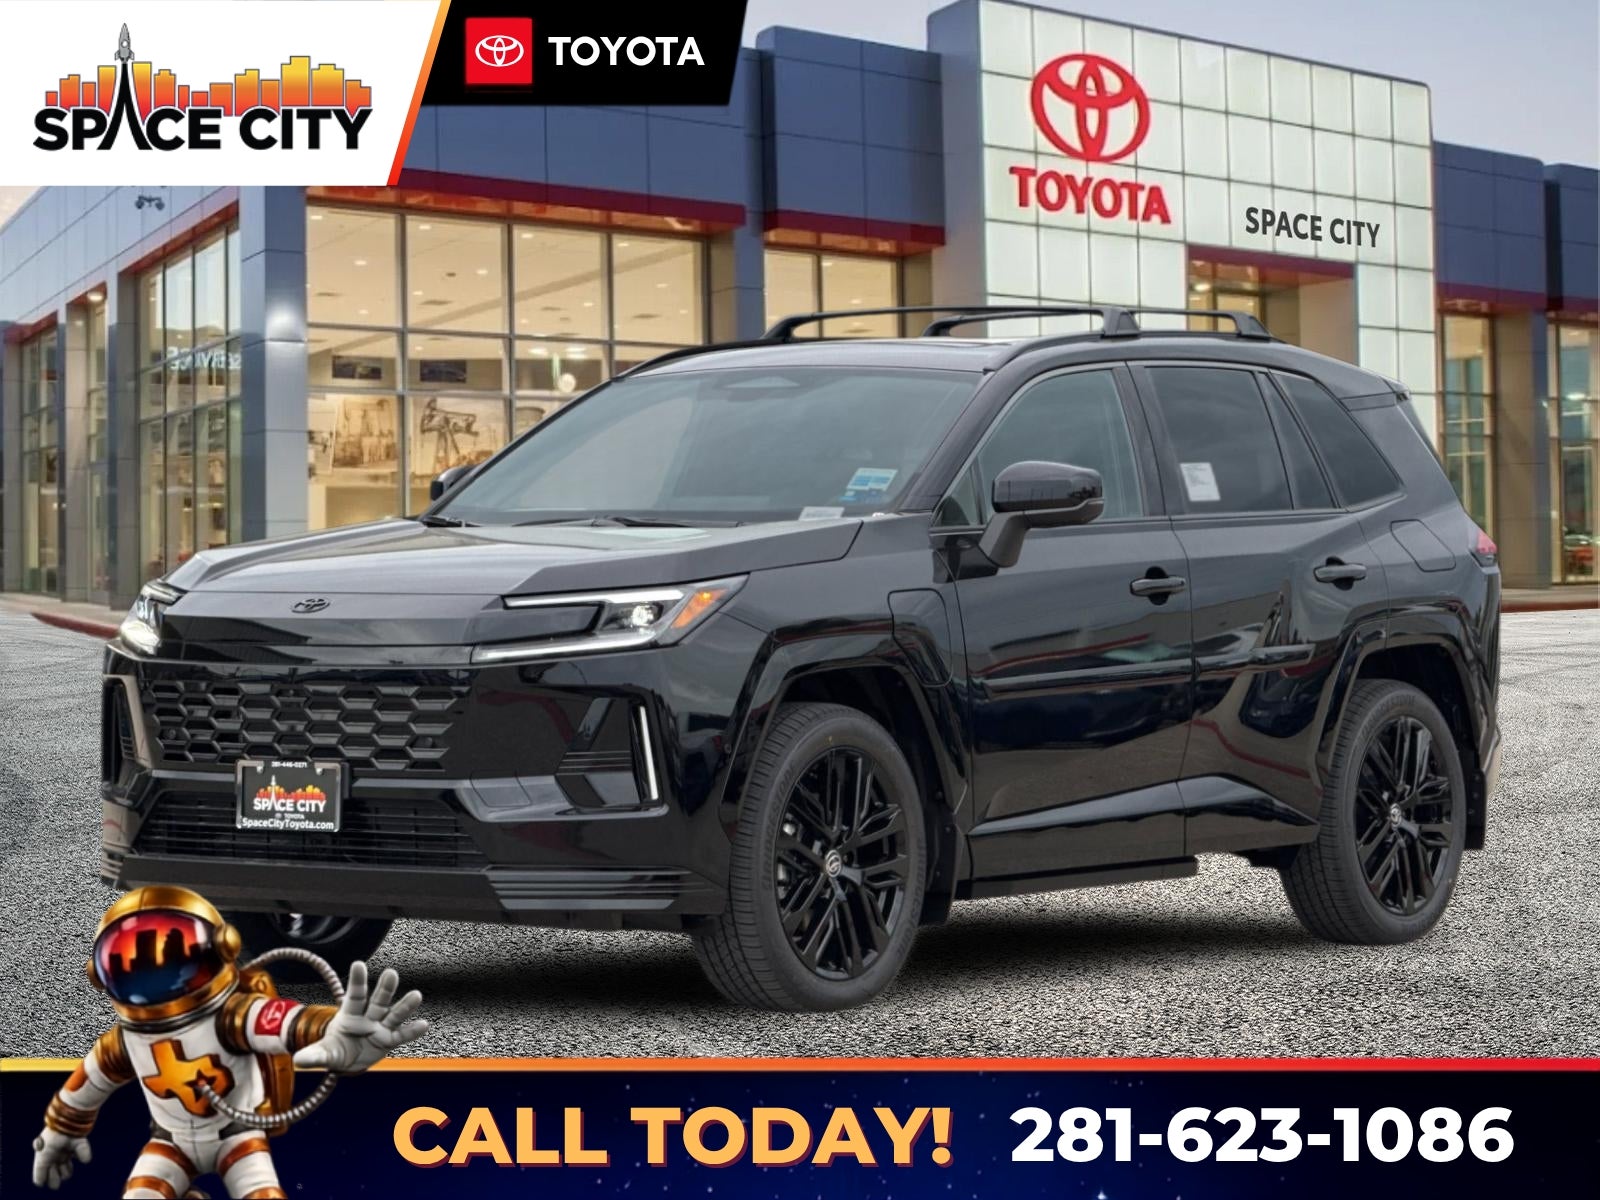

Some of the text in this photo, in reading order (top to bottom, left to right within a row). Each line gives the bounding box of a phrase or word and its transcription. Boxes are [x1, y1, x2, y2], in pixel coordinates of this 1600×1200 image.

[1009, 166, 1171, 224] TOYOTA
[1245, 206, 1381, 248] SPACE CITY
[253, 797, 326, 812] SPACE CITY
[242, 818, 334, 830] SpaceCityToyota.com
